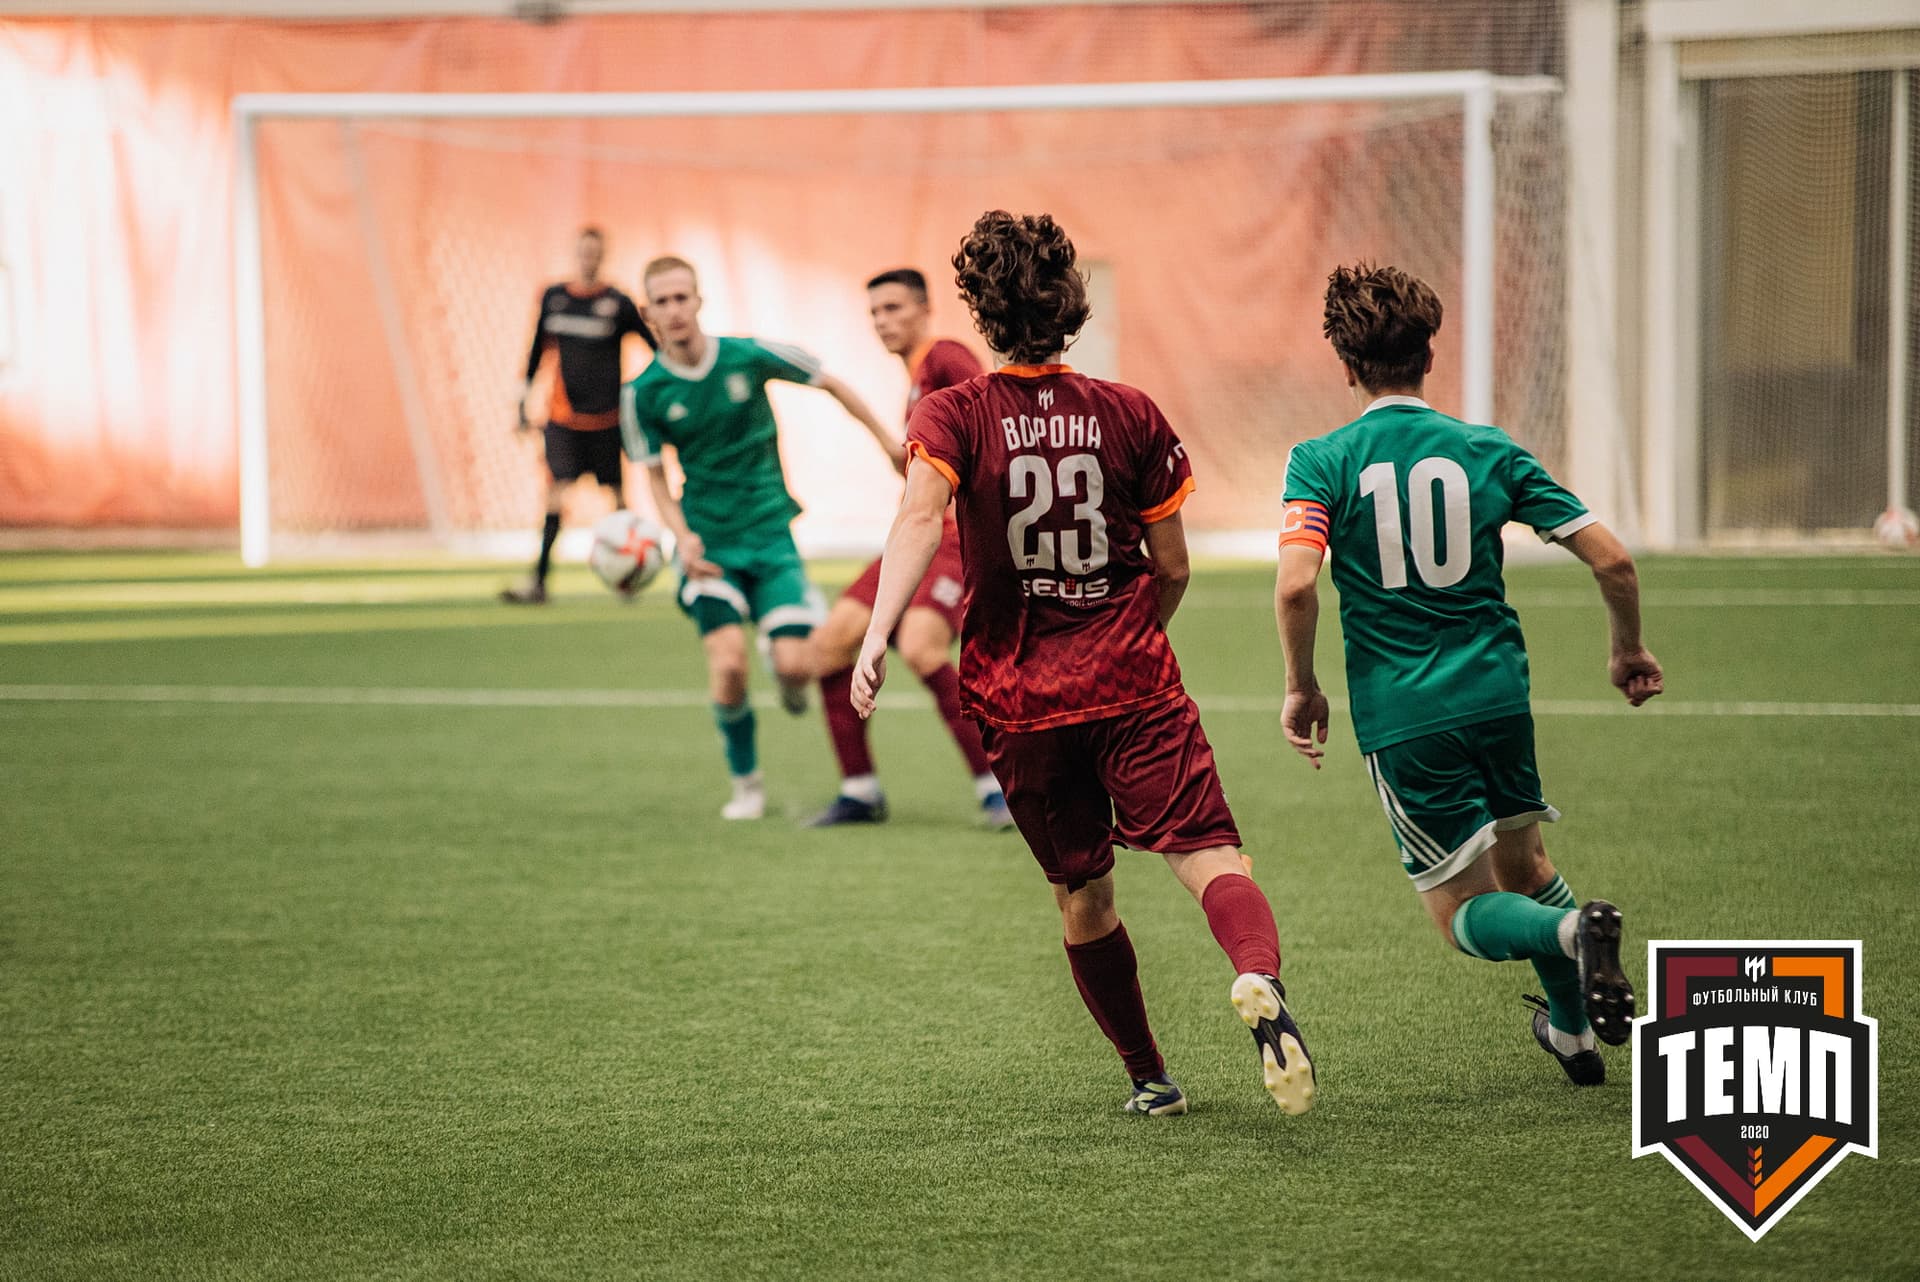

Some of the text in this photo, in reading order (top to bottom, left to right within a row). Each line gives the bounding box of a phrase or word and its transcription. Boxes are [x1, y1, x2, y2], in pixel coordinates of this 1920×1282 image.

[1002, 414, 1101, 451] ВОРОНА
[1007, 454, 1108, 575] 23
[1280, 506, 1303, 533] C
[1359, 456, 1472, 589] 10
